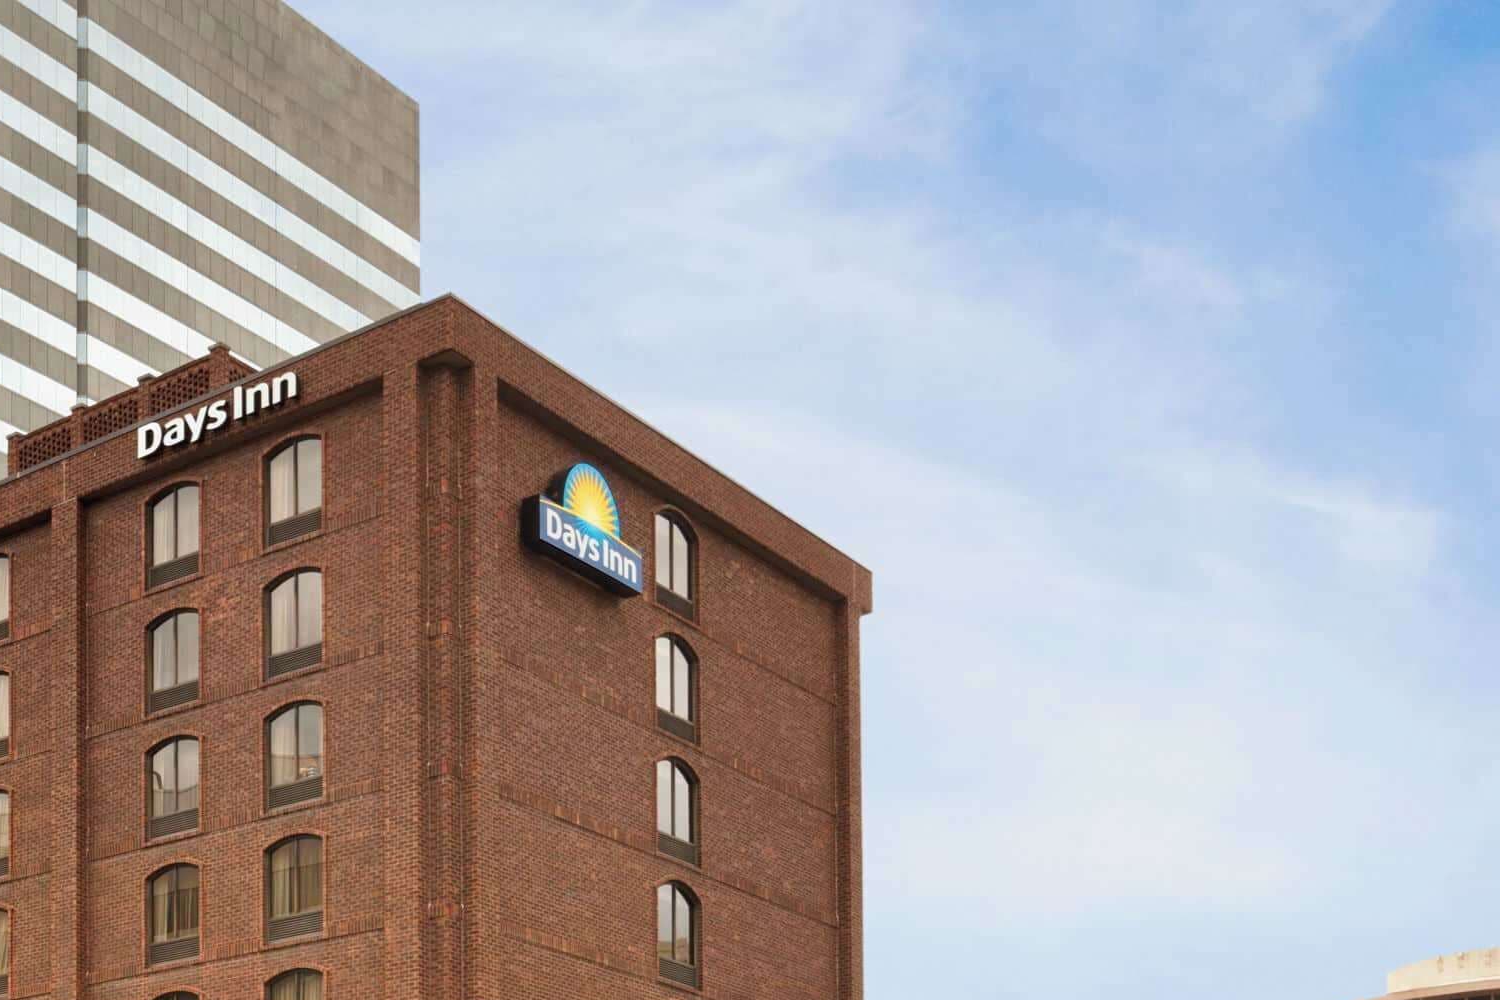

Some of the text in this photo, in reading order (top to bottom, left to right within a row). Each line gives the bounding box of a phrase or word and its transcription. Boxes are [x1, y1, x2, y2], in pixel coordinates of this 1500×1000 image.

[137, 371, 297, 459] Days Inn
[546, 507, 637, 583] Days Inn
